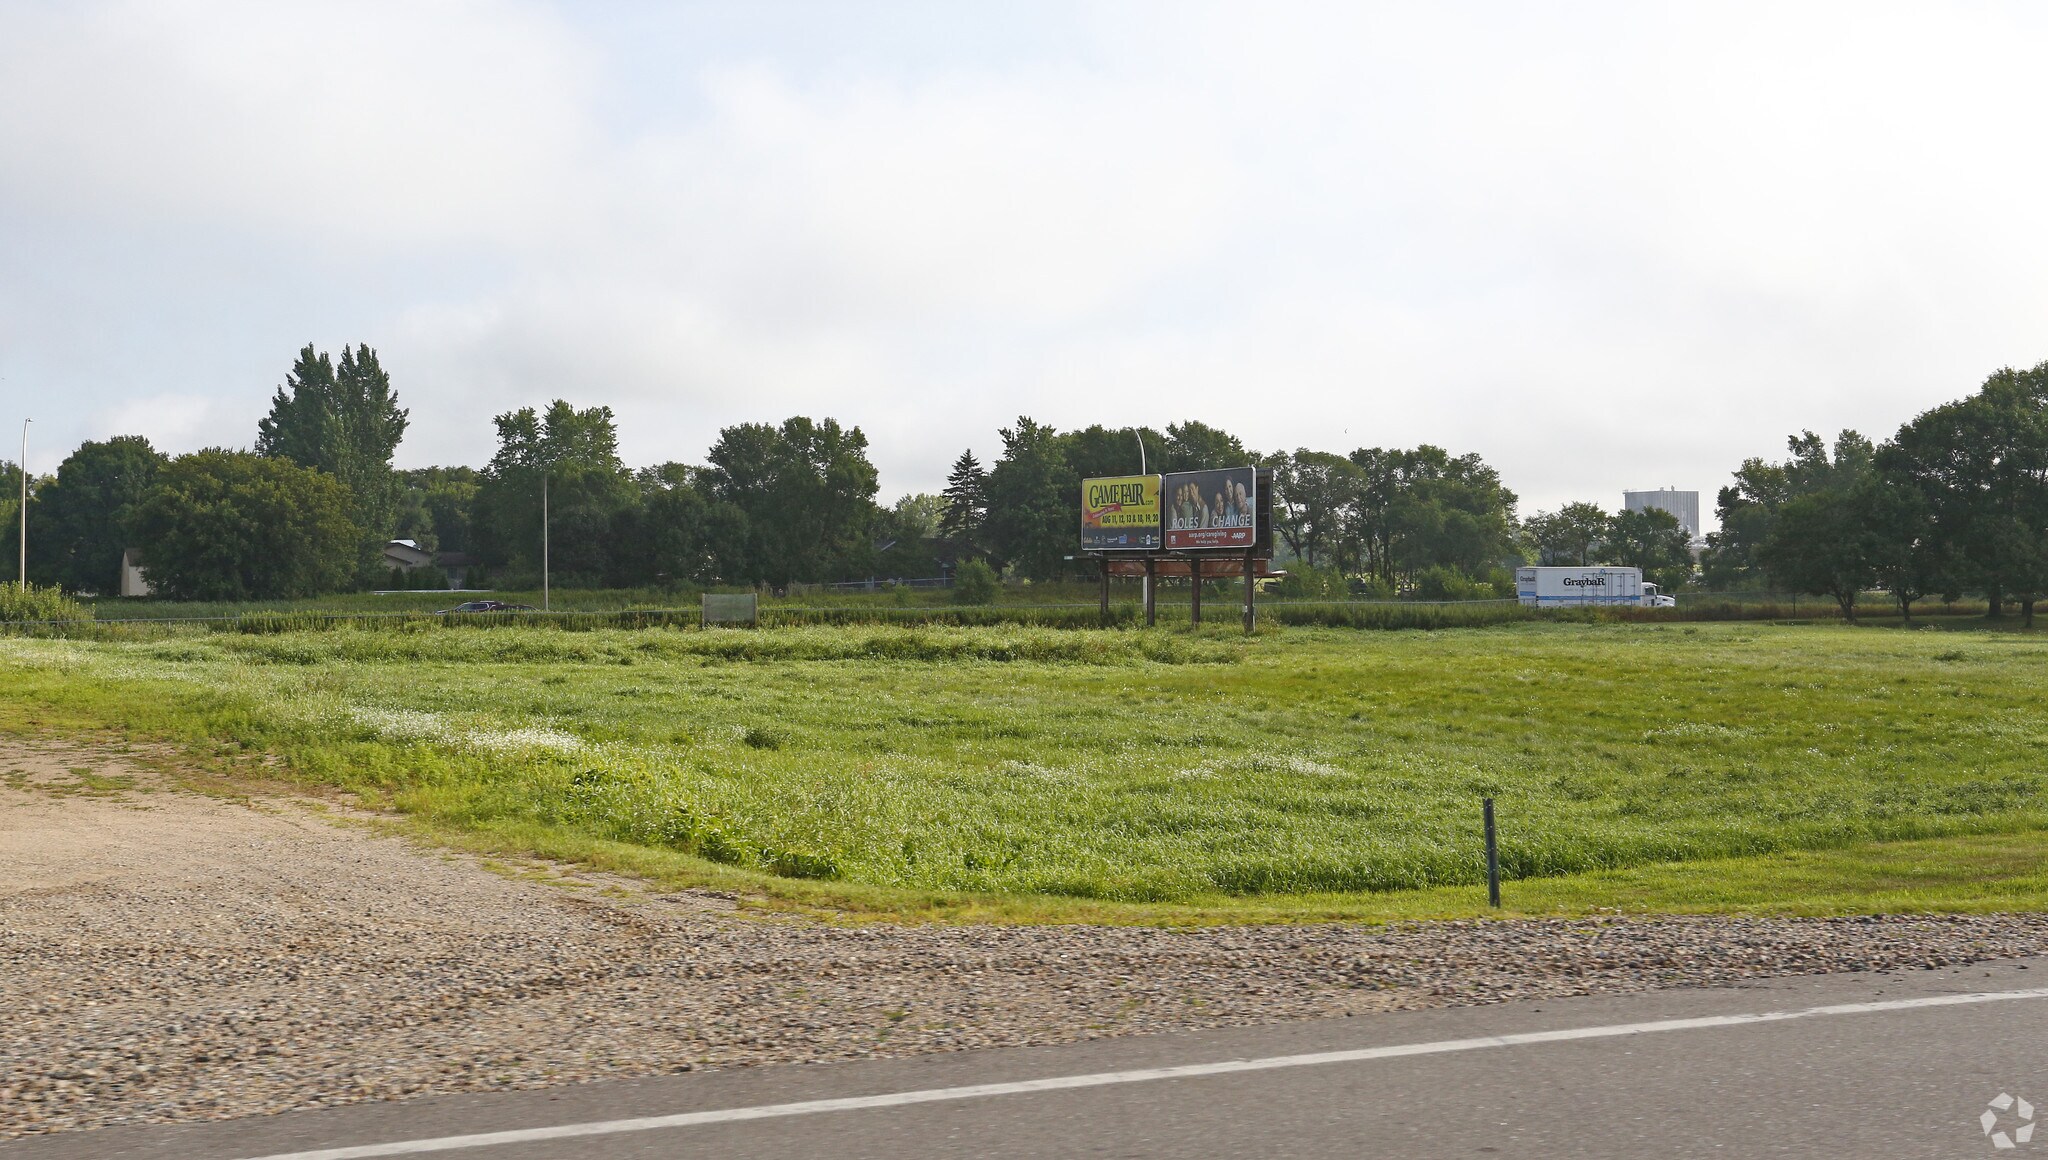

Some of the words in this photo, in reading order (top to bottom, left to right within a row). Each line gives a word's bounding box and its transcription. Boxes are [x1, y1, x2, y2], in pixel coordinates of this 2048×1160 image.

[1102, 515, 1111, 524] AUG
[1126, 514, 1132, 523] 13
[1152, 513, 1159, 522] 20
[1172, 517, 1199, 529] ROLES
[1212, 514, 1251, 527] CHANGE
[1188, 531, 1227, 539] aarp.org/caregiving
